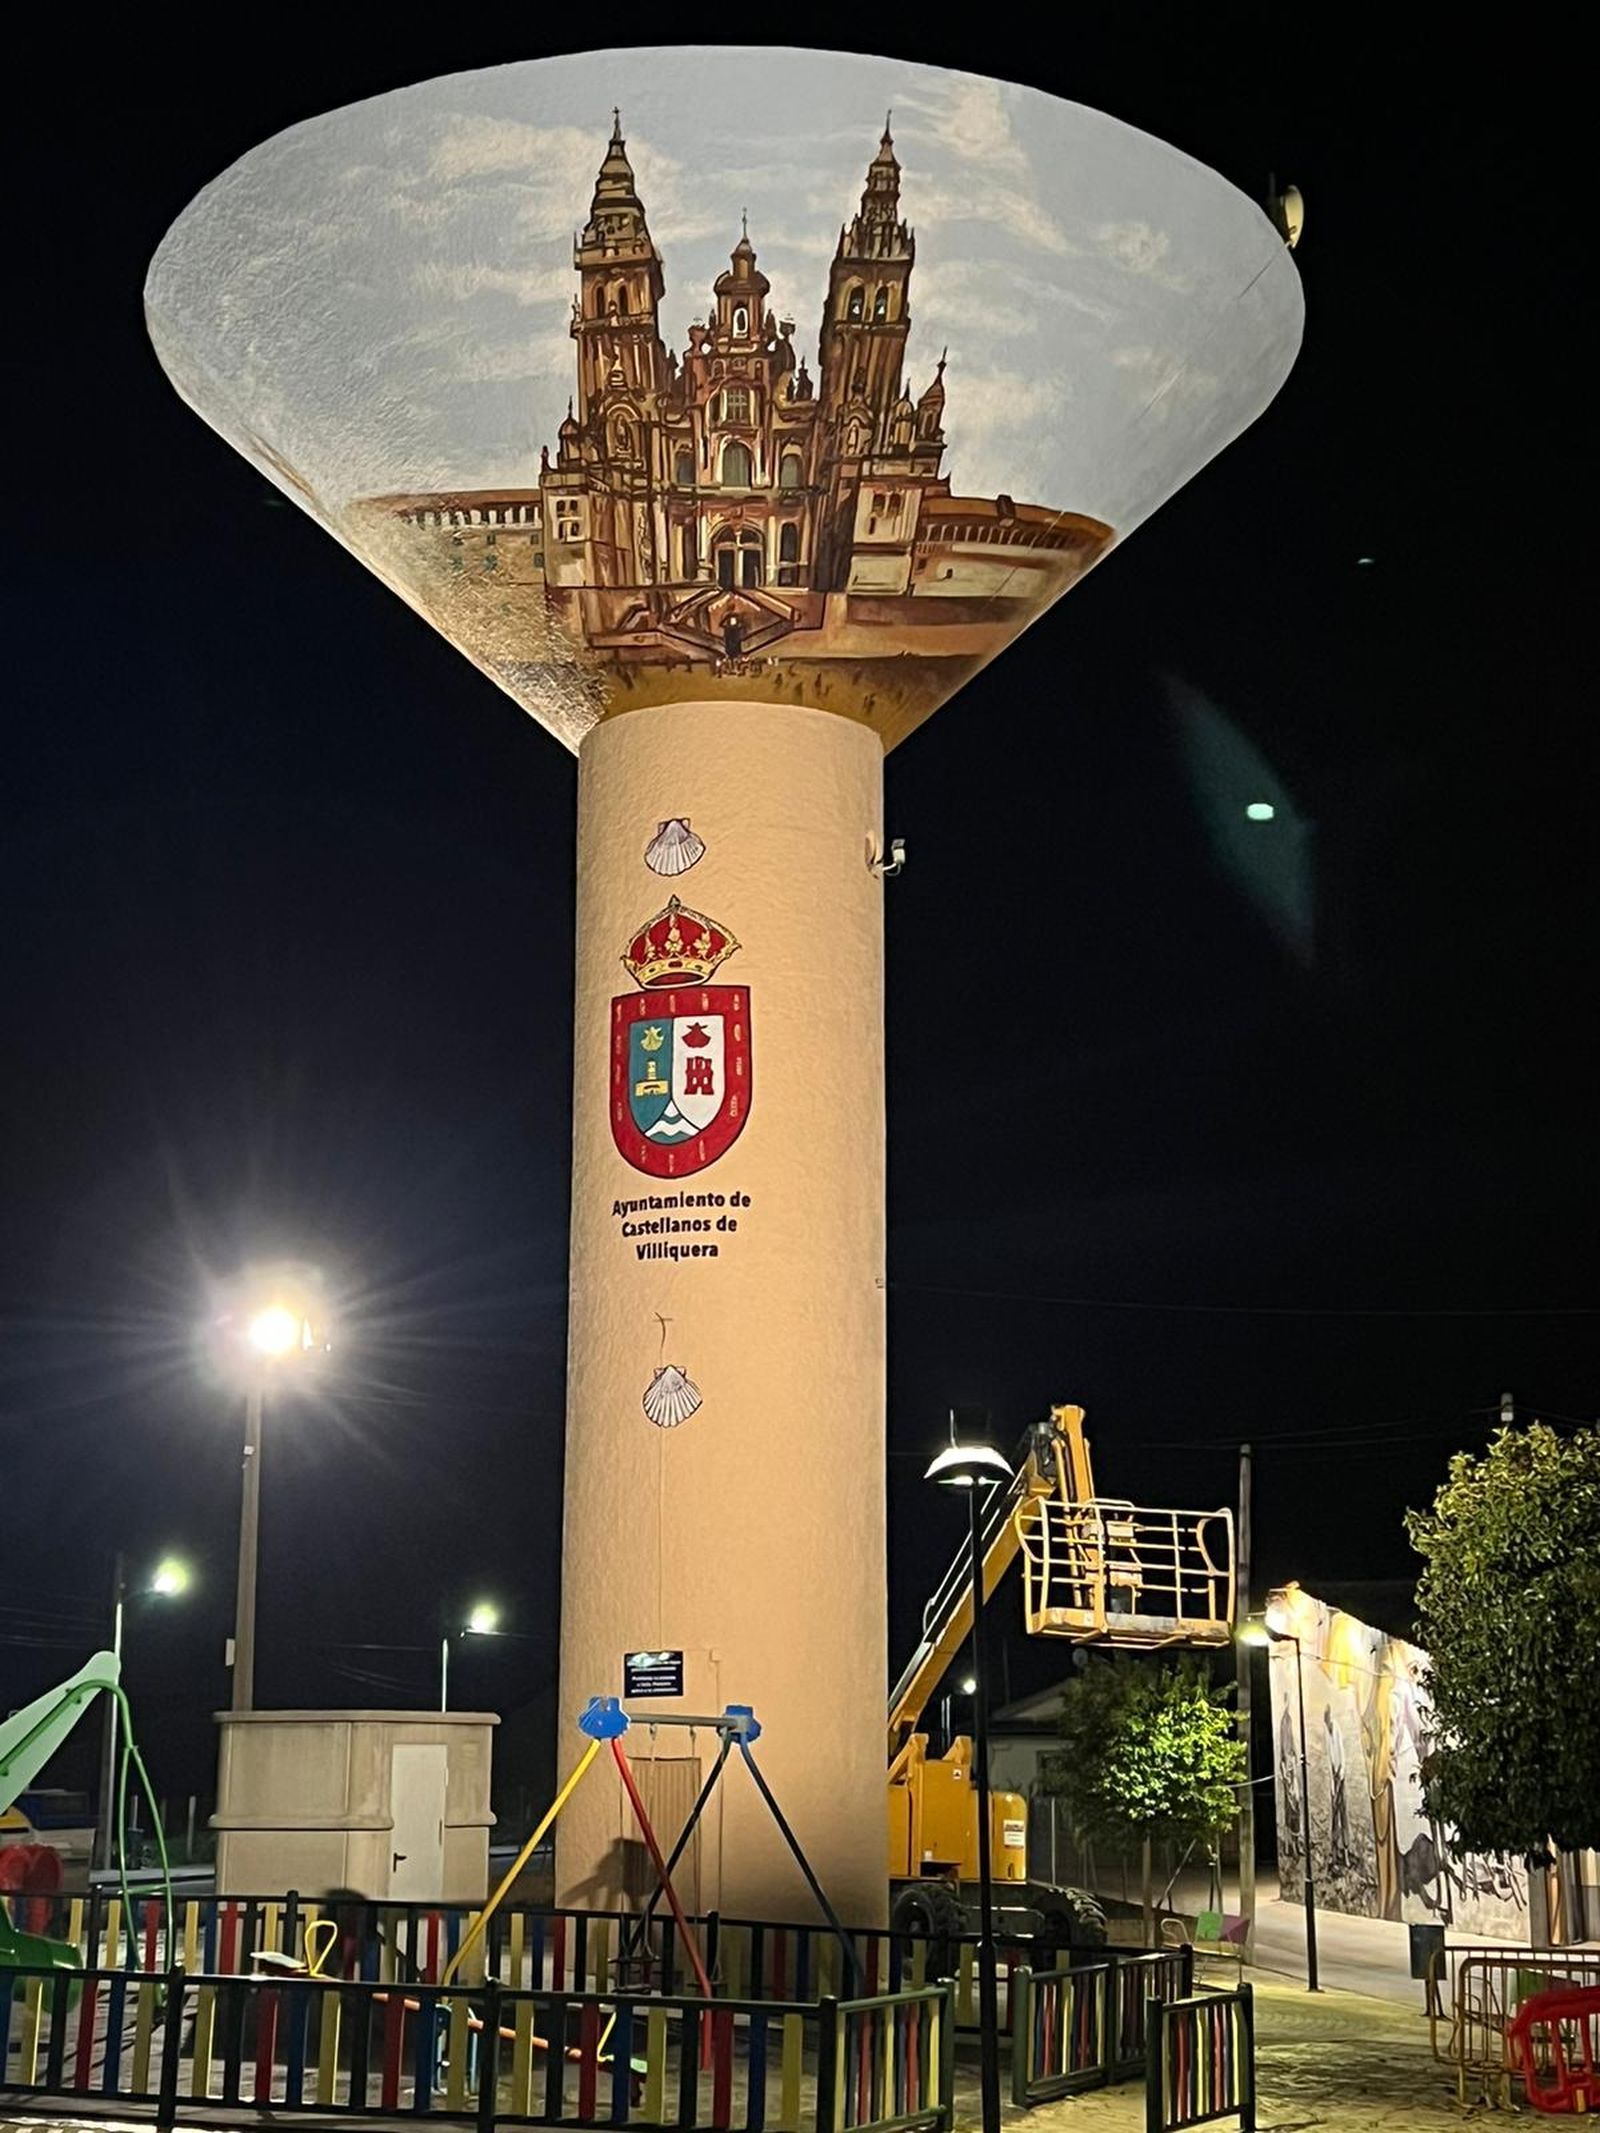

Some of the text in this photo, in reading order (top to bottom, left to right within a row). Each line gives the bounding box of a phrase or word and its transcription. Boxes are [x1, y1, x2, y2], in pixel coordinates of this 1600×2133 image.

[611, 1191, 752, 1218] Ayuntamiento de
[622, 1215, 738, 1237] Castellanos de
